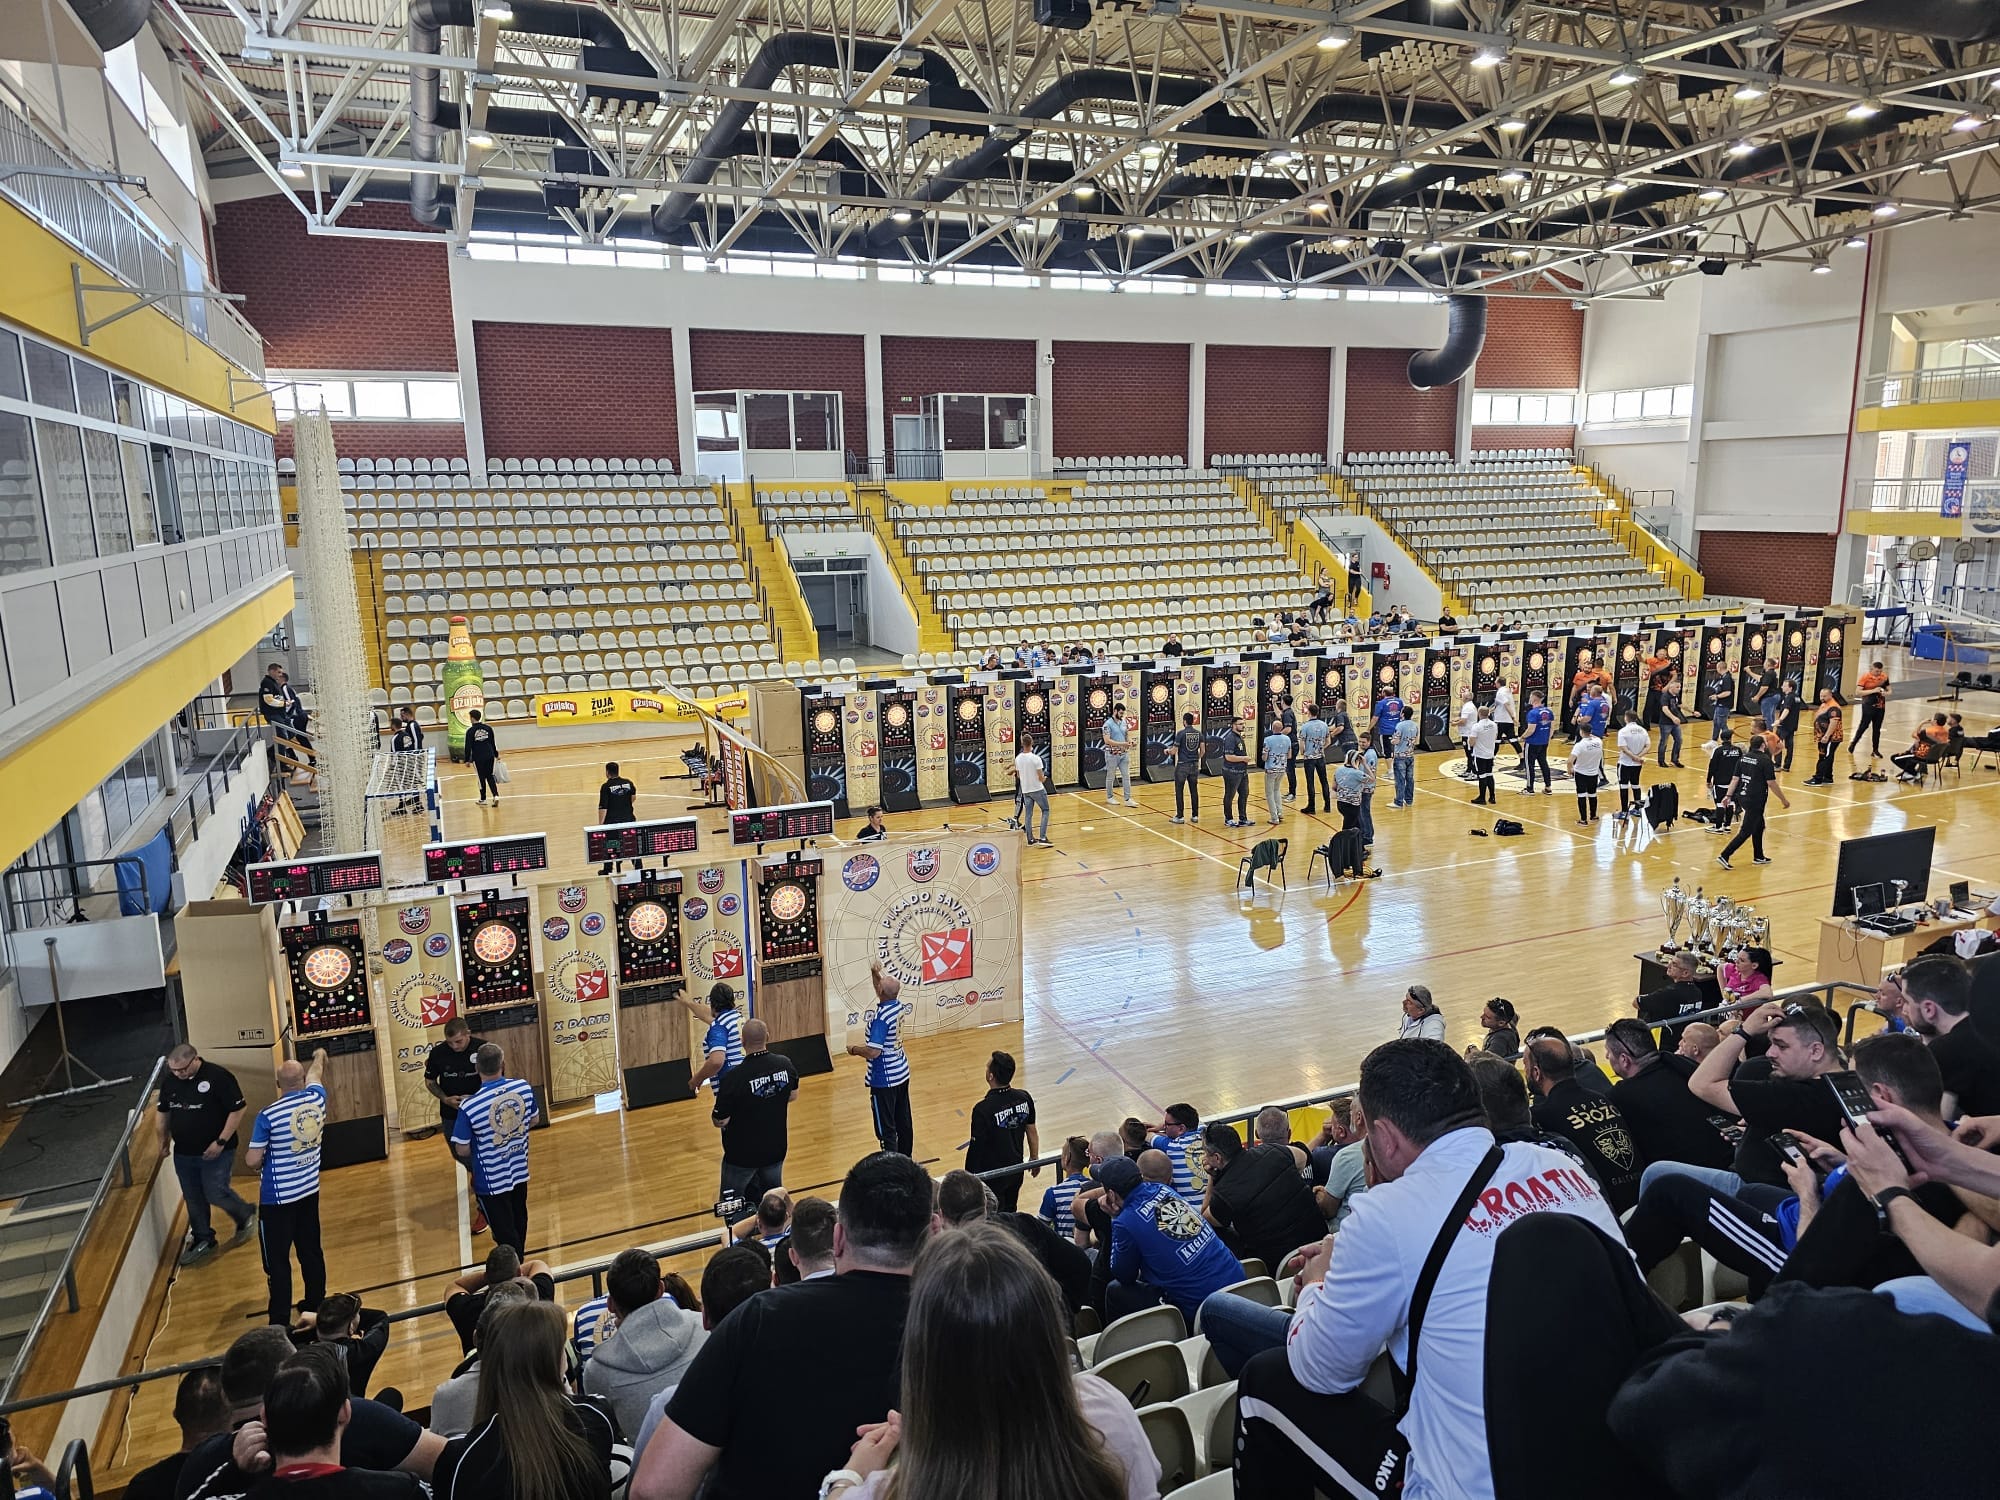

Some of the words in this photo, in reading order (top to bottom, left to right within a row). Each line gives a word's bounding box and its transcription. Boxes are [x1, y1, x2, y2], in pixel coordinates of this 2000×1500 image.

[790, 852, 797, 860] 4
[487, 890, 494, 898] 2
[314, 912, 322, 921] 1
[936, 893, 971, 927] SAVEZ
[583, 950, 607, 969] SAVEZ
[428, 972, 454, 993] SAVEZ
[554, 1021, 564, 1031] X
[568, 1013, 610, 1029] DARTS
[847, 1010, 859, 1025] X
[398, 1048, 410, 1058] X
[749, 1074, 771, 1093] TEAM
[1570, 1098, 1607, 1113] EPIC
[994, 1107, 1015, 1126] TEAM
[1464, 1168, 1600, 1237] CROATIA
[1375, 1449, 1399, 1491] JAKO
